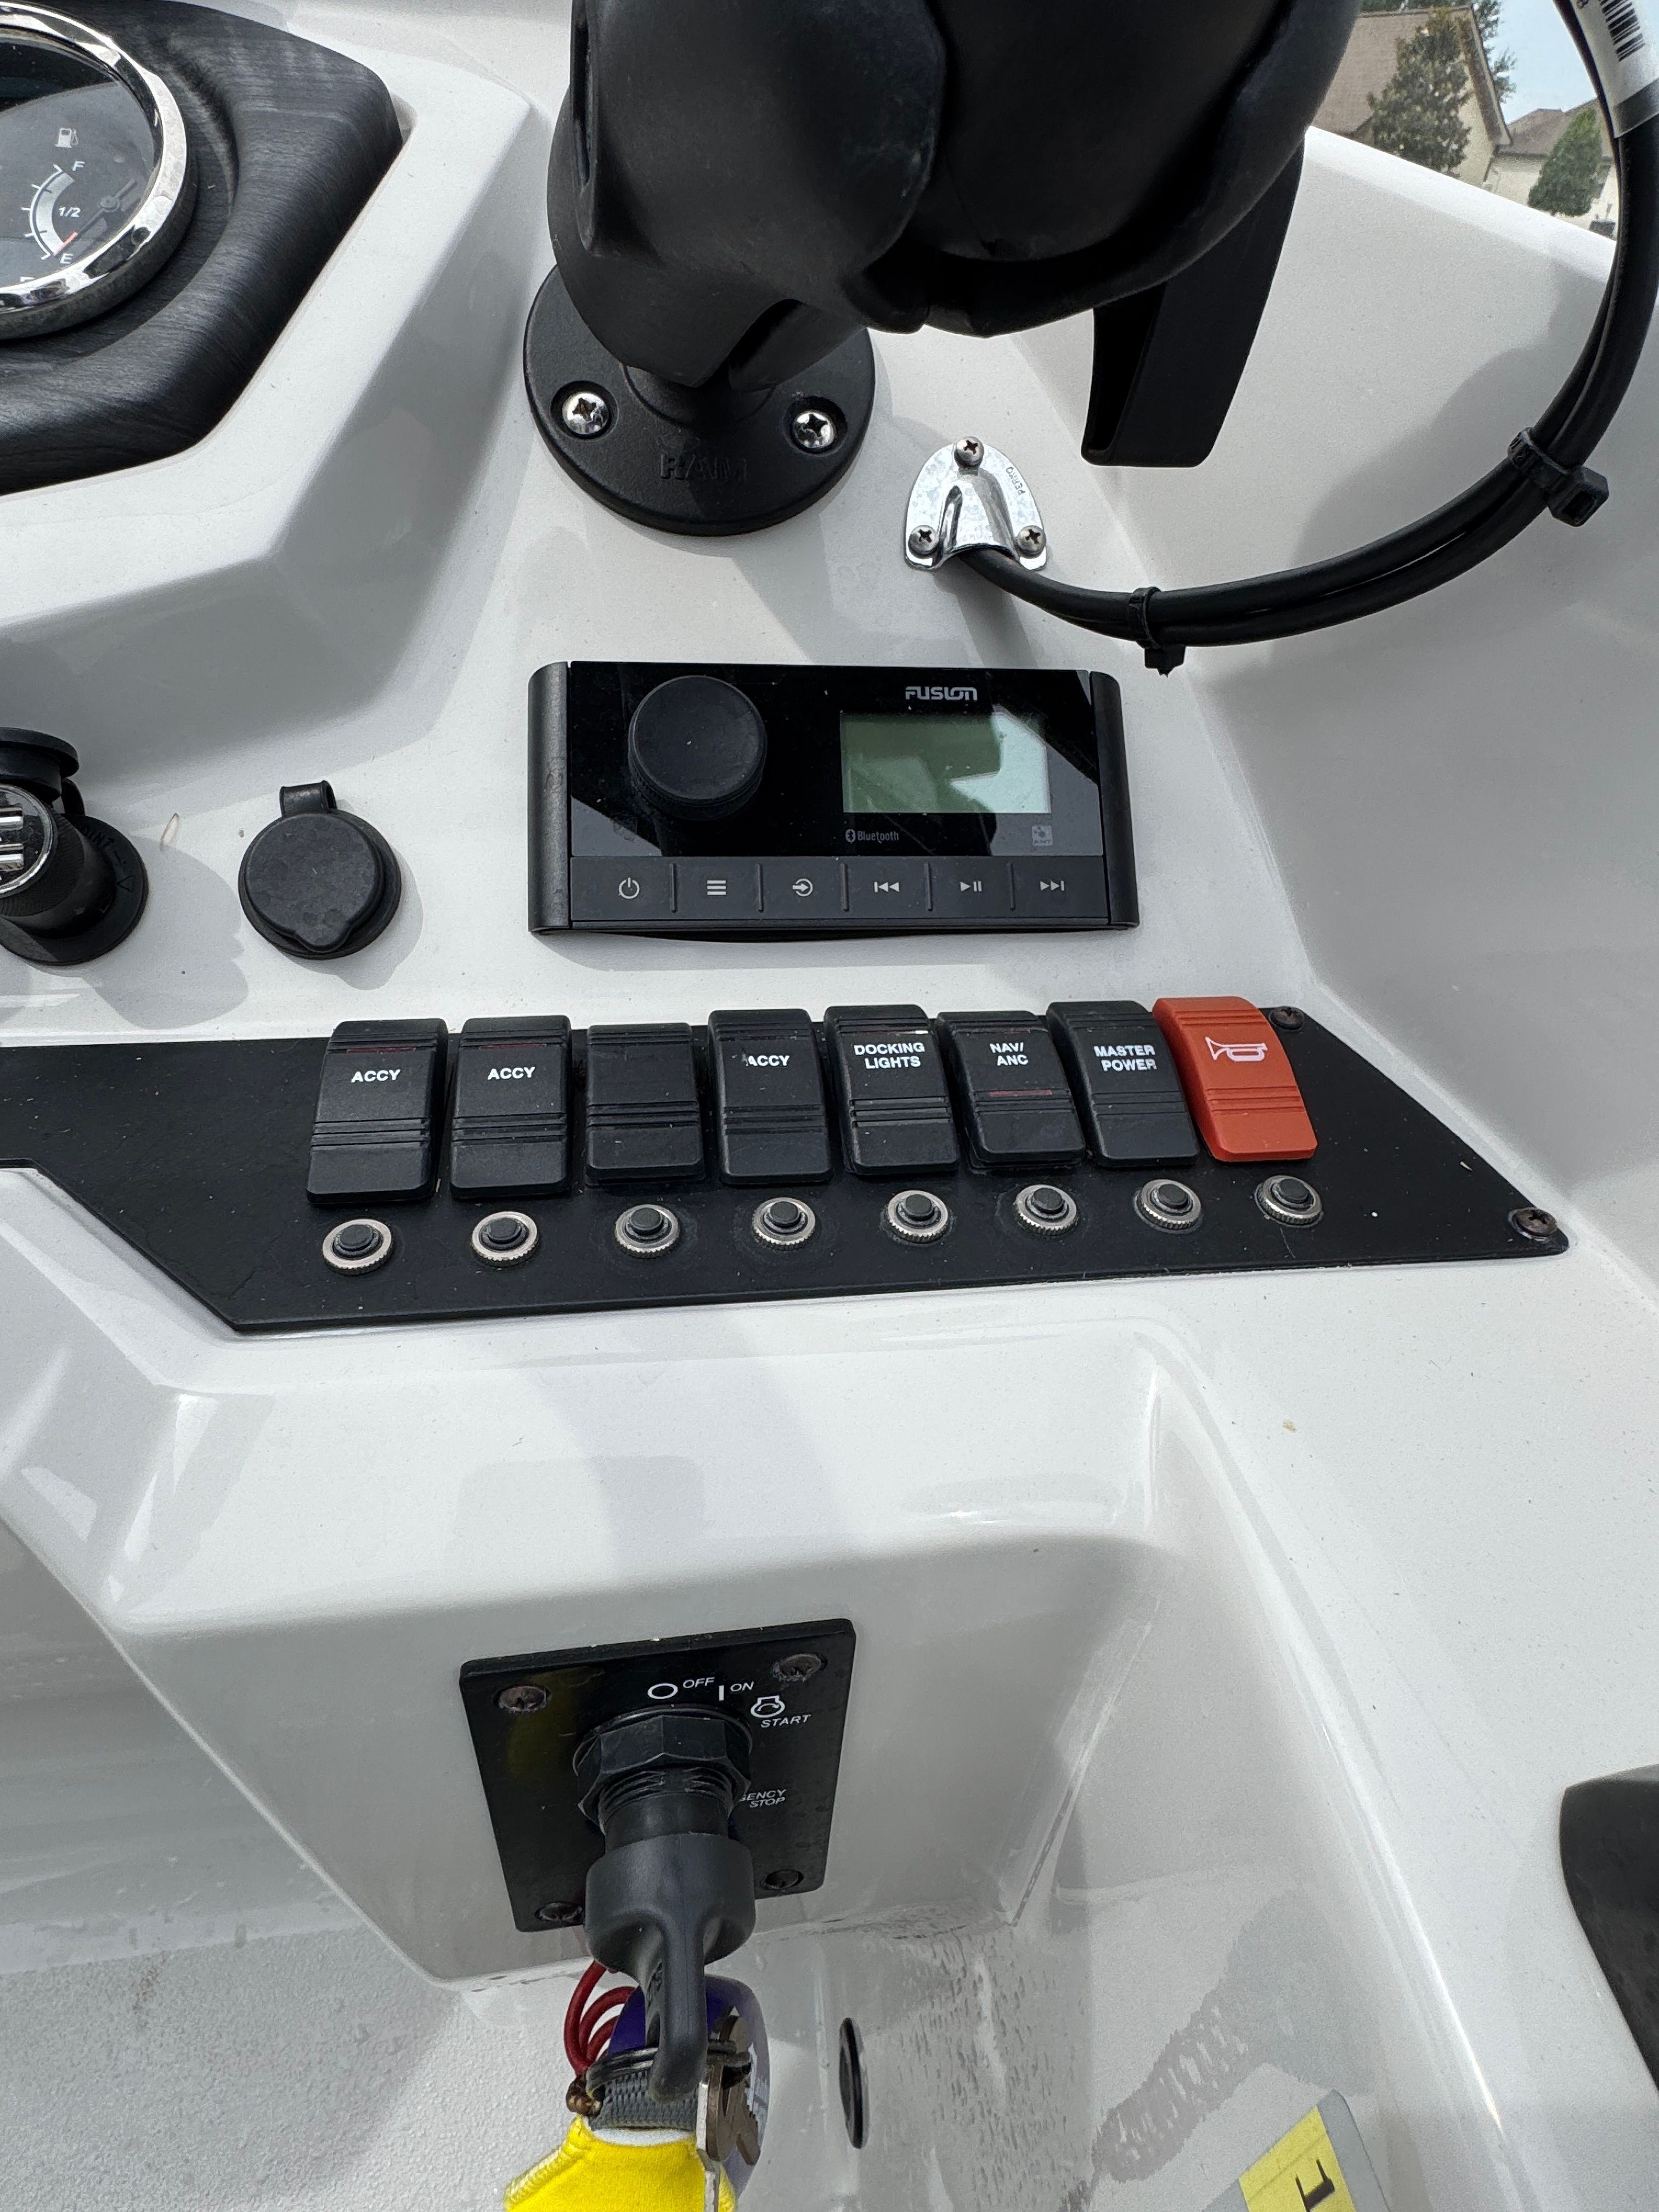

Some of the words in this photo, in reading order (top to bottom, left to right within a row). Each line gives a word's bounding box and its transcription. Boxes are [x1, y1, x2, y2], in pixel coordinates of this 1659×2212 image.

[72, 160, 85, 171] F
[58, 206, 81, 218] 1/2
[59, 253, 74, 264] E
[659, 453, 748, 483] RAM
[905, 686, 978, 701] FUSION
[857, 830, 900, 844] Bluetooth
[854, 1042, 926, 1056] DOCKING
[990, 1042, 1024, 1053] NAV/
[1093, 1045, 1155, 1057] MASTER
[743, 1053, 790, 1067] ACCY
[865, 1056, 921, 1069] LIGHTS
[997, 1054, 1029, 1066] ANC
[1101, 1059, 1156, 1071] POWER
[351, 1069, 400, 1083] ACCY
[487, 1066, 535, 1080] ACCY
[682, 1677, 715, 1689] OFF
[730, 1681, 755, 1692] ON
[760, 1714, 812, 1729] START
[749, 1797, 786, 1808] STOP
